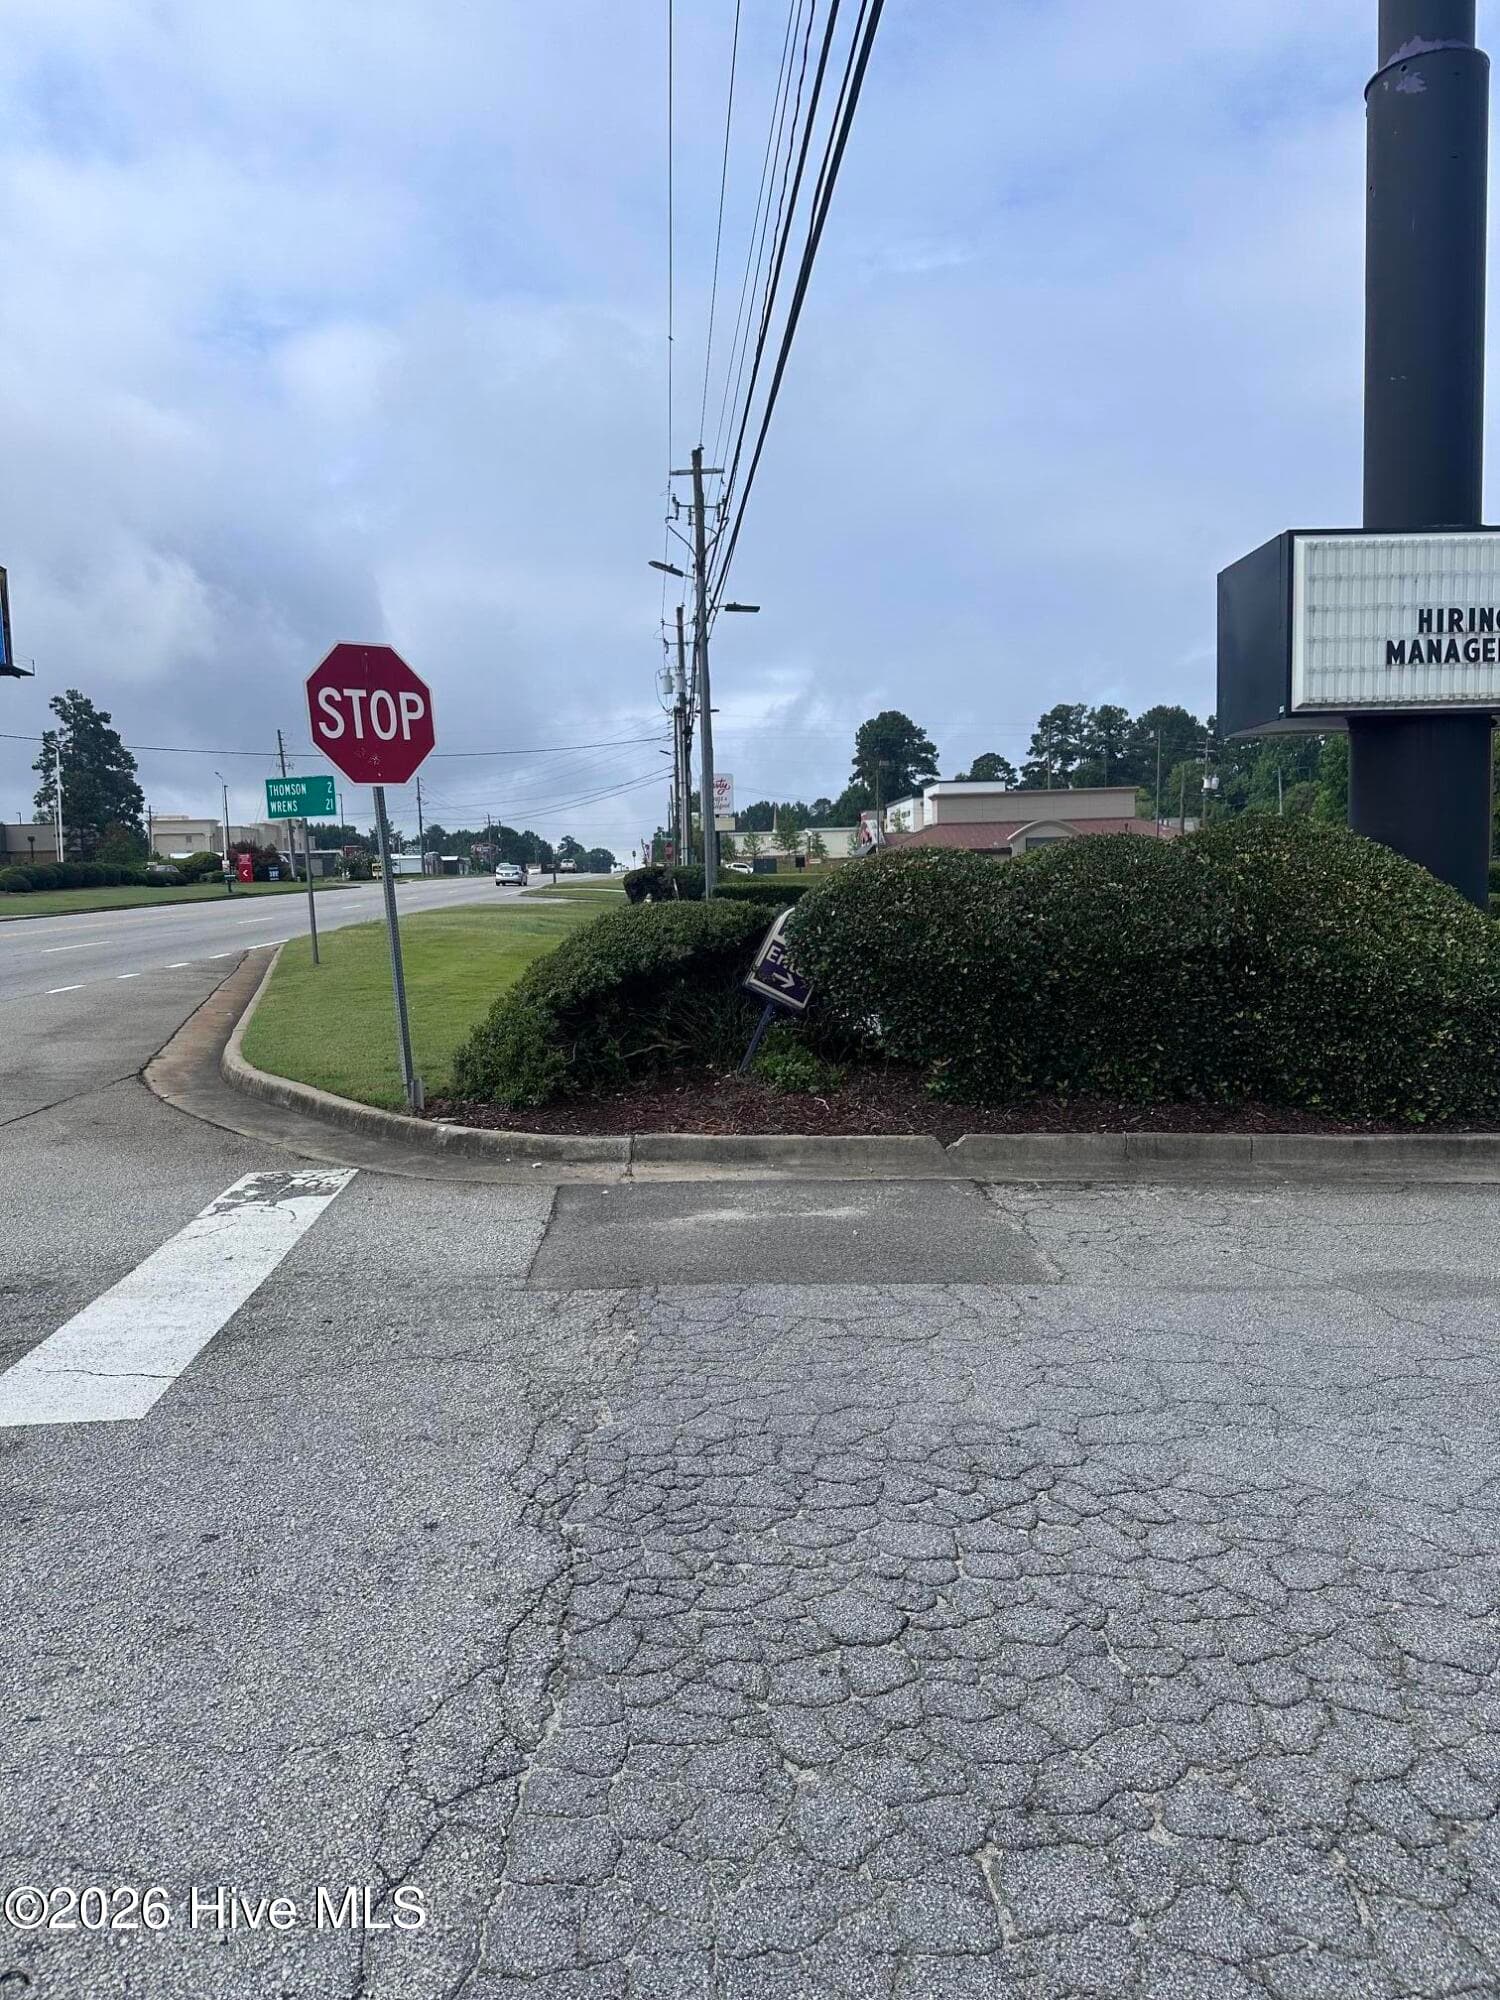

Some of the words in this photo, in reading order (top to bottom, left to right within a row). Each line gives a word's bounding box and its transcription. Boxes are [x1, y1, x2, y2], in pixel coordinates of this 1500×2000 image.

[1418, 607, 1500, 633] HIRIN
[1386, 637, 1500, 665] MANAGE
[318, 686, 425, 741] STOP
[268, 783, 307, 797] THOMSON
[326, 781, 333, 794] 2
[270, 800, 298, 813] WRENS
[325, 798, 334, 811] 21
